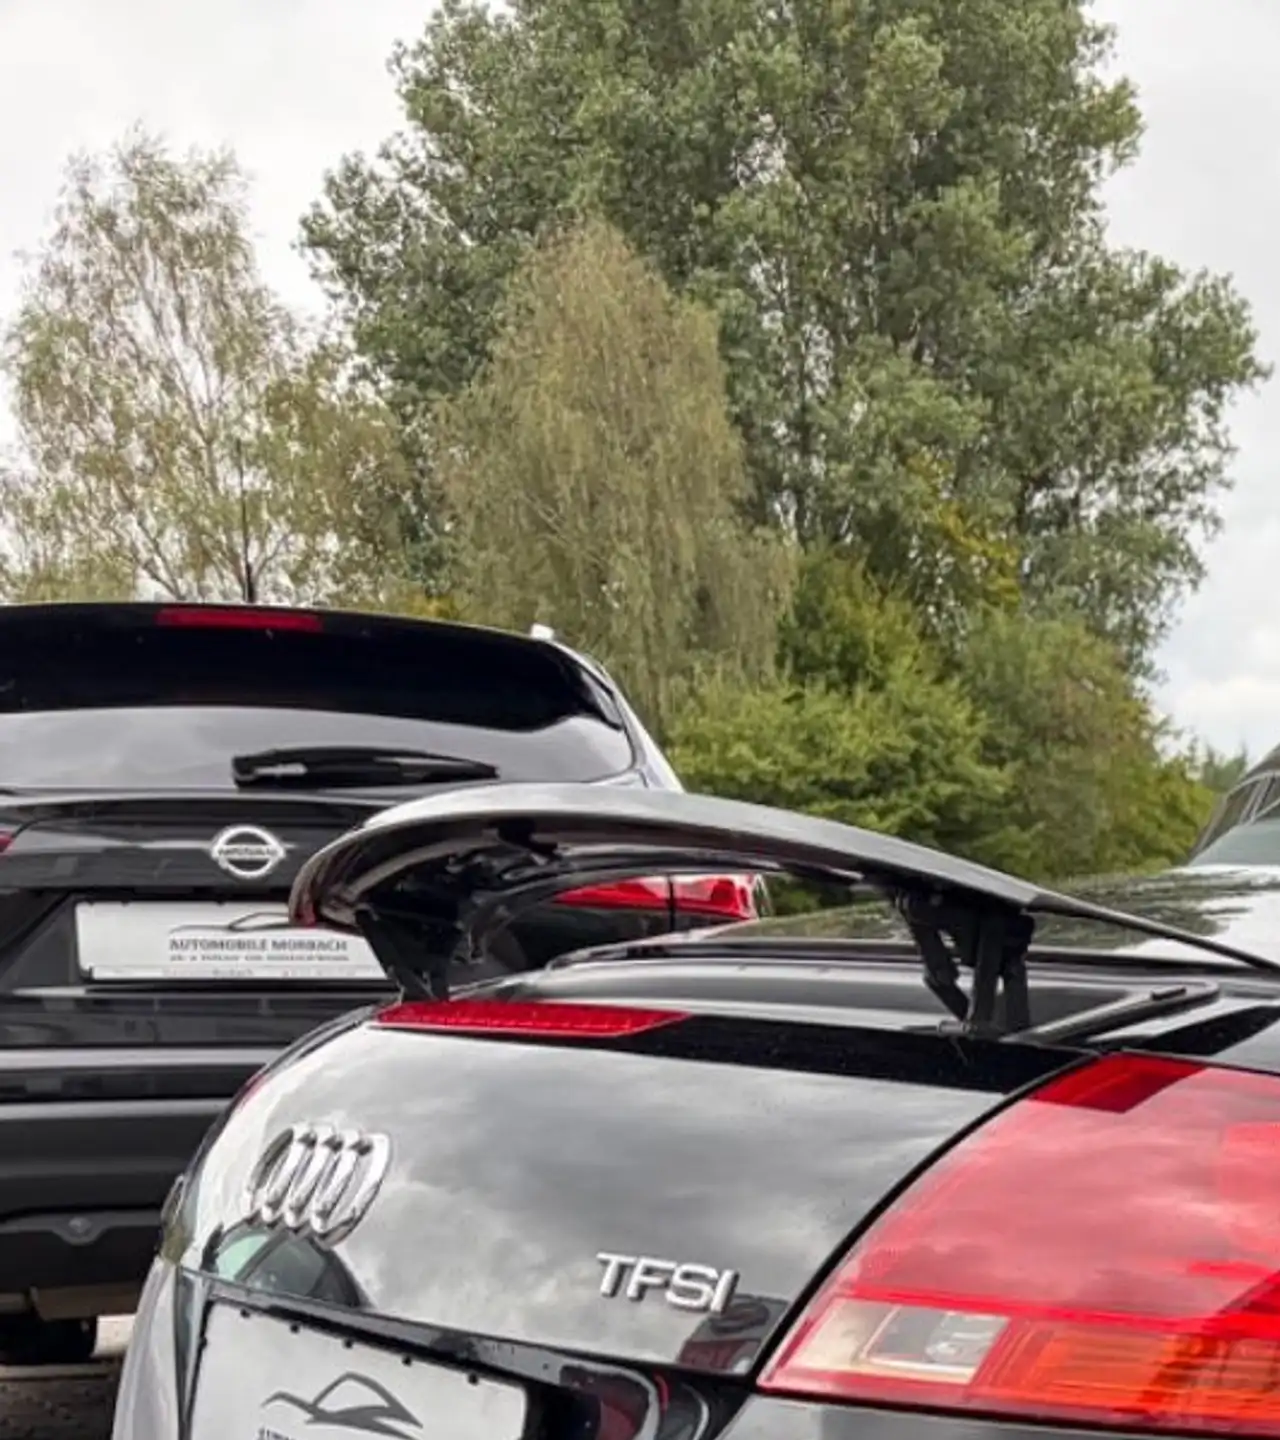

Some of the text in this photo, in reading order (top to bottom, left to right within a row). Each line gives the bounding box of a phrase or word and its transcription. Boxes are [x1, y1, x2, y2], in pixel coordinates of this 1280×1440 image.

[170, 938, 348, 952] AUTOMOBILE MORBACH
[597, 1252, 739, 1316] TFSI
